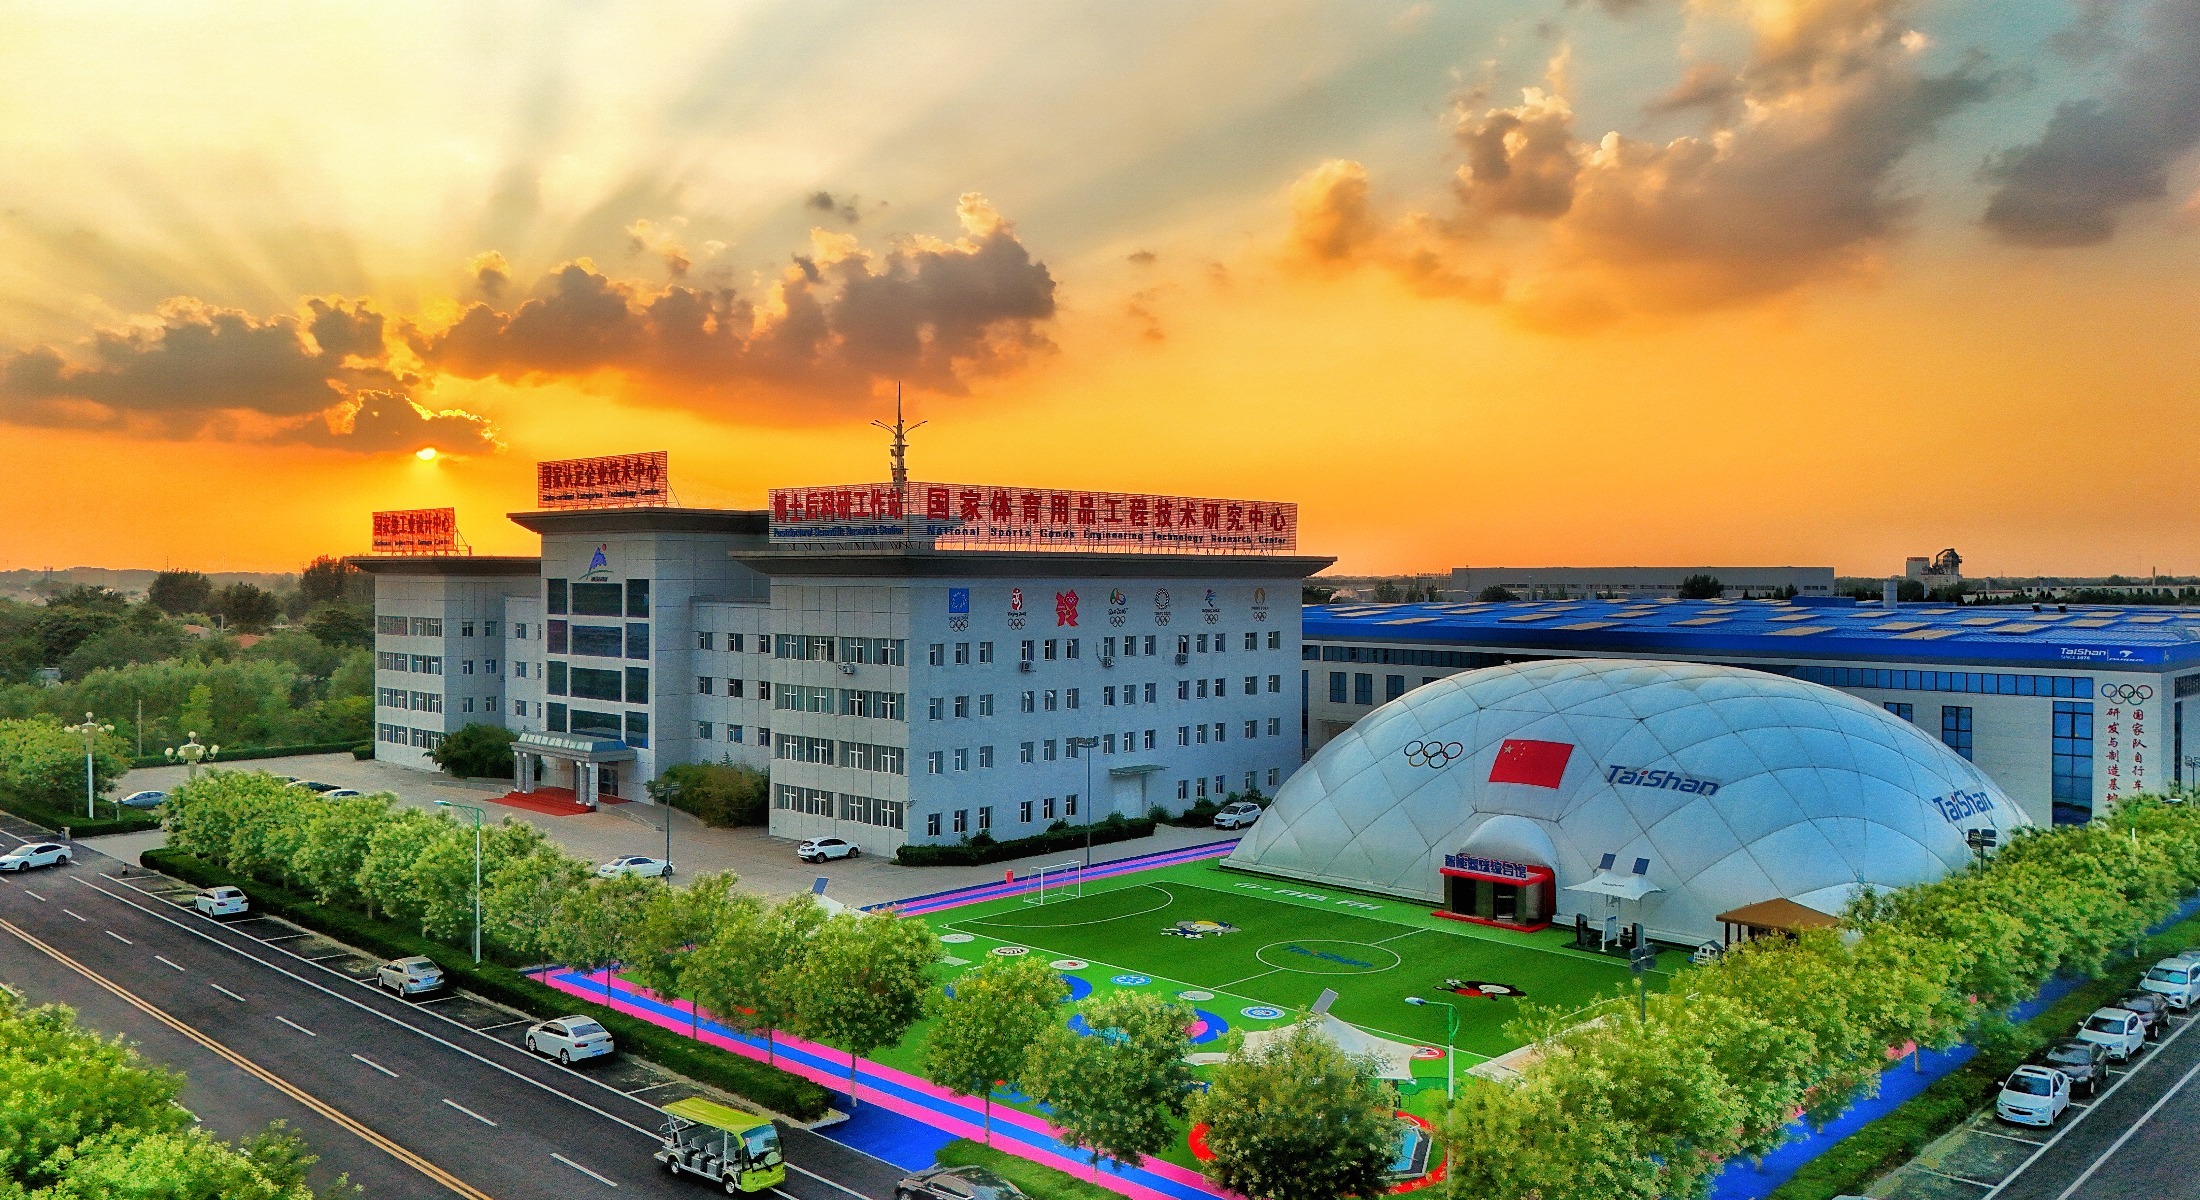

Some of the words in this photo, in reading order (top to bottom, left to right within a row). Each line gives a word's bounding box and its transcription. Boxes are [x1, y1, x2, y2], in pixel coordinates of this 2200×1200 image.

[543, 457, 660, 489] 国家认定企业技术中心
[773, 489, 903, 522] 博士后科研工作站
[927, 487, 1287, 532] 国家体育用品工程技术研究中心
[927, 525, 980, 536] National
[990, 526, 1032, 538] Sports
[1039, 527, 1076, 539] Goods
[1083, 527, 1144, 542] Engineering
[1152, 531, 1204, 543] Technology
[1211, 534, 1251, 543] Research
[1258, 535, 1287, 544] Center
[2060, 647, 2107, 657] TaiShan
[1607, 764, 1720, 796] TaiShan
[1932, 789, 1994, 823] TaiShan
